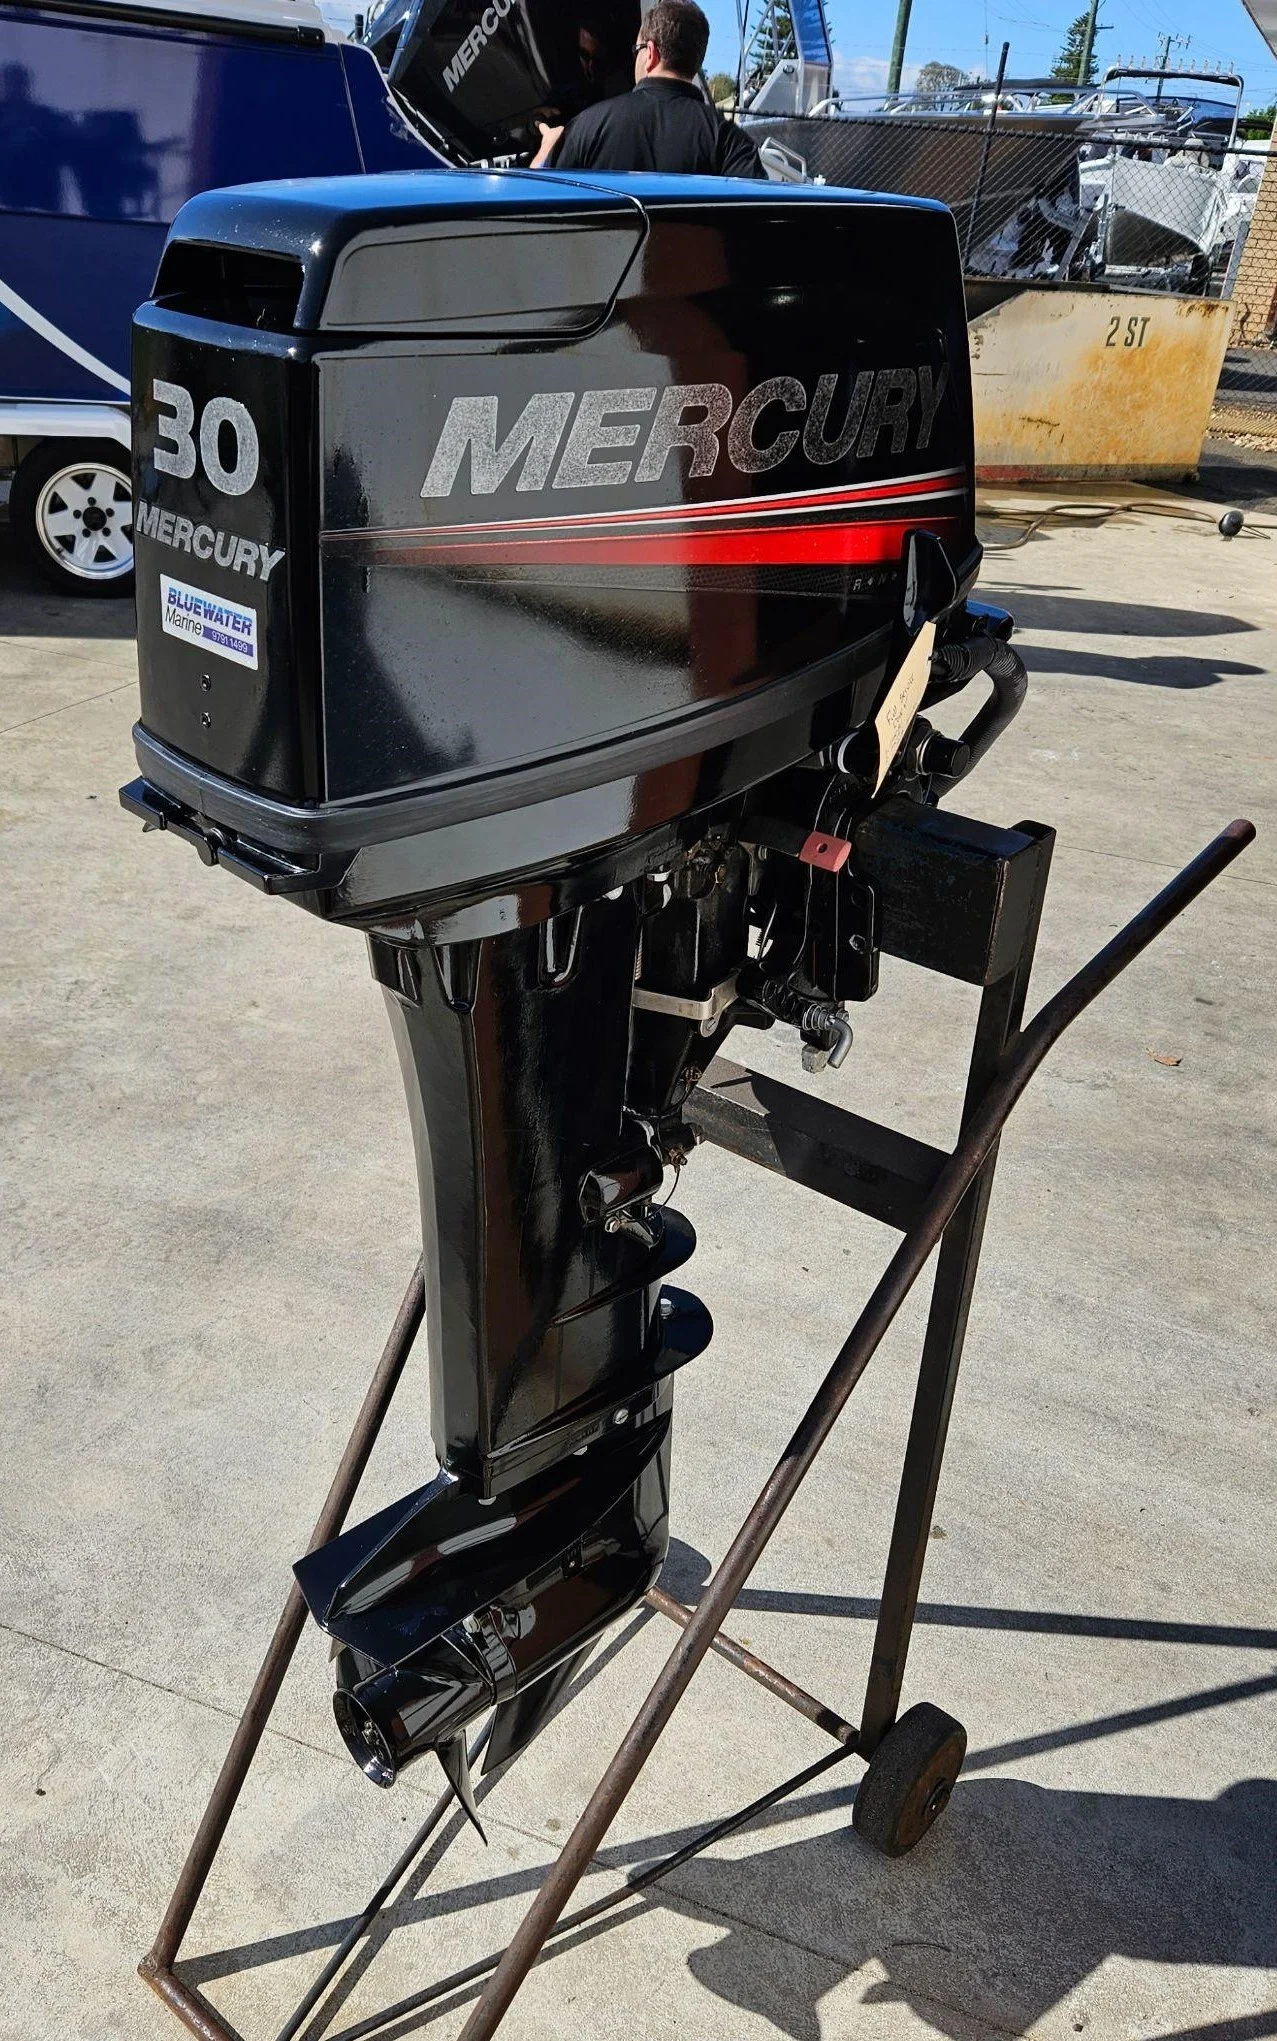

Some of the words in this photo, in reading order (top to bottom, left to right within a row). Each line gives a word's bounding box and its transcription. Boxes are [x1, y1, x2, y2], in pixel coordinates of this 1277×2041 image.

[442, 0, 516, 94] MERCU
[1106, 316, 1121, 347] 2
[1124, 316, 1151, 348] ST
[153, 378, 260, 496] 30
[420, 365, 948, 498] MERCURY
[135, 500, 286, 582] MERCURY
[165, 605, 203, 636] Marine
[167, 587, 253, 636] BLUEWATER
